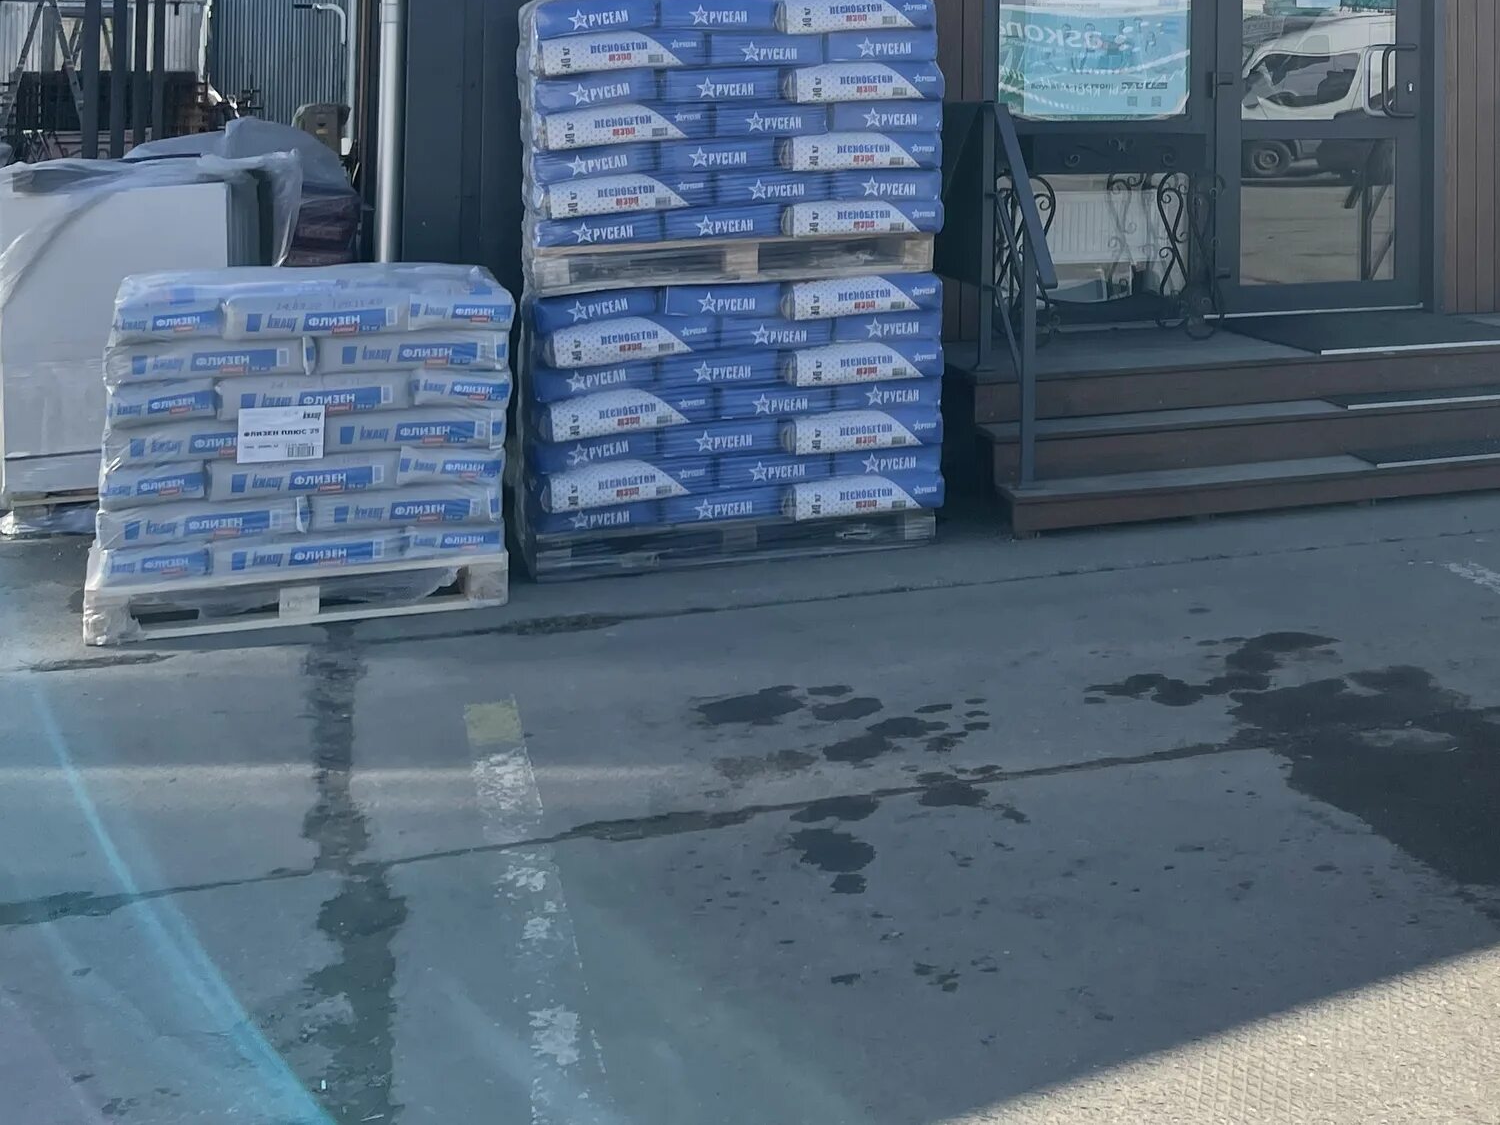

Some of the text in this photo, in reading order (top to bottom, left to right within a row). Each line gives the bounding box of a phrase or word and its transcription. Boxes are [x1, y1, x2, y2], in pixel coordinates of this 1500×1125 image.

[588, 10, 629, 26] РУСЕАН
[709, 9, 748, 24] РУСЕАН
[760, 48, 797, 60] РУСЕАН
[875, 42, 912, 55] РУСЕАН
[590, 83, 630, 101] РУСЕАН
[716, 82, 754, 96] РУСЕАН
[765, 116, 801, 130] РУСЕАН
[881, 113, 918, 126] РУСЕАН
[588, 154, 628, 172] РУСЕАН
[709, 151, 747, 165] РУСЕАН
[767, 183, 804, 197] РУСЕАН
[880, 183, 916, 196] РУСЕАН
[715, 218, 753, 233] РУСЕАН
[593, 225, 634, 241] РУСЕАН
[587, 298, 628, 317] РУСЕАН
[716, 298, 755, 311] РУСЕАН
[455, 307, 495, 316] ФЛИЗЕН
[156, 315, 200, 327] ФЛИЗЕН
[308, 315, 360, 327] ФЛИЗЕН
[883, 322, 919, 335] РУСЕАН
[770, 330, 807, 344] РУСЕАН
[402, 347, 453, 357] ФЛИЗЕН
[196, 355, 249, 366] ФЛИЗЕН
[586, 369, 627, 388] РУСЕАН
[712, 365, 751, 380] РУСЕАН
[454, 384, 493, 394] ФЛИЗЕН
[151, 397, 196, 410] ФЛИЗЕН
[303, 393, 355, 405] ФЛИЗЕН
[883, 390, 919, 404] РУСЕАН
[771, 398, 808, 412] РУСЕАН
[400, 425, 450, 437] ФЛИЗЕН
[714, 434, 752, 449] РУСЕАН
[589, 440, 629, 460] РУСЕАН
[445, 462, 485, 471] ФЛИЗЕН
[880, 456, 916, 469] РУСЕАН
[768, 464, 805, 479] РУСЕАН
[140, 478, 185, 491] ФЛИЗЕН
[294, 473, 346, 485] ФЛИЗЕН
[394, 504, 446, 515] ФЛИЗЕН
[714, 501, 753, 516] РУСЕАН
[189, 517, 243, 529] ФЛИЗЕН
[590, 511, 630, 526] РУСЕАН
[445, 535, 484, 544] ФЛИЗЕН
[294, 548, 347, 560] ФЛИЗЕН
[144, 557, 189, 568] ФЛИЗЕН
